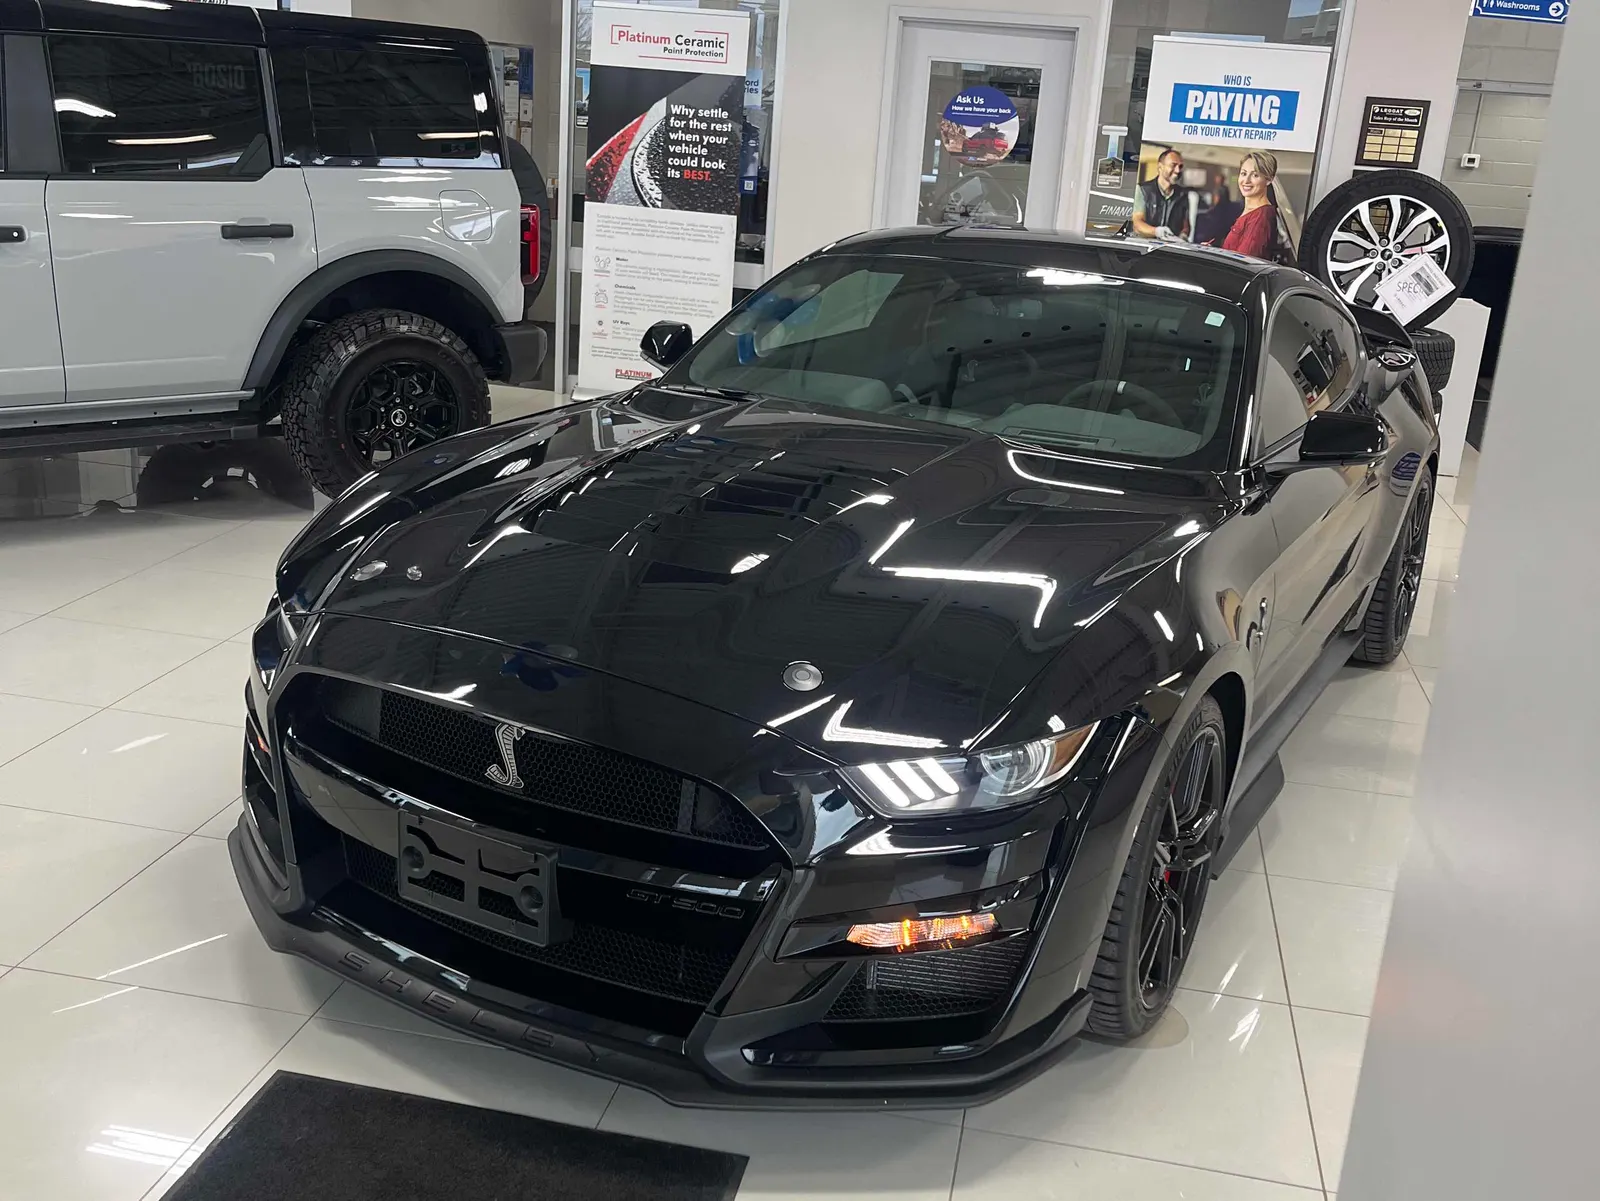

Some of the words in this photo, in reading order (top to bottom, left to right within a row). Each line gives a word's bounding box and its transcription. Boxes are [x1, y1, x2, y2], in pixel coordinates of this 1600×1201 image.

[1496, 0, 1540, 11] Washrooms
[617, 30, 671, 45] Platinum
[675, 34, 725, 49] Ceramic
[663, 46, 683, 55] Paint
[685, 47, 724, 58] Protection
[745, 79, 759, 87] ord
[1223, 74, 1242, 86] WHO
[1243, 76, 1252, 87] IS
[956, 95, 972, 104] Ask
[973, 96, 985, 105] Us
[1184, 89, 1281, 125] PAYING
[670, 104, 696, 119] Why
[697, 107, 729, 119] settle
[669, 117, 687, 128] for
[689, 118, 708, 130] the
[710, 122, 733, 132] rest
[669, 130, 700, 142] when
[702, 135, 729, 146] your
[1182, 124, 1199, 136] FOR
[1200, 125, 1221, 138] YOUR
[1221, 127, 1243, 139] NEXT
[1243, 128, 1277, 142] REPAIR?
[668, 143, 709, 156] vehicle
[667, 156, 698, 168] could
[701, 157, 726, 170] look
[667, 167, 681, 179] its
[683, 169, 712, 182] BEST.
[1099, 203, 1133, 218] FINANC
[615, 368, 652, 380] PLATINUM
[626, 888, 745, 919] GT500
